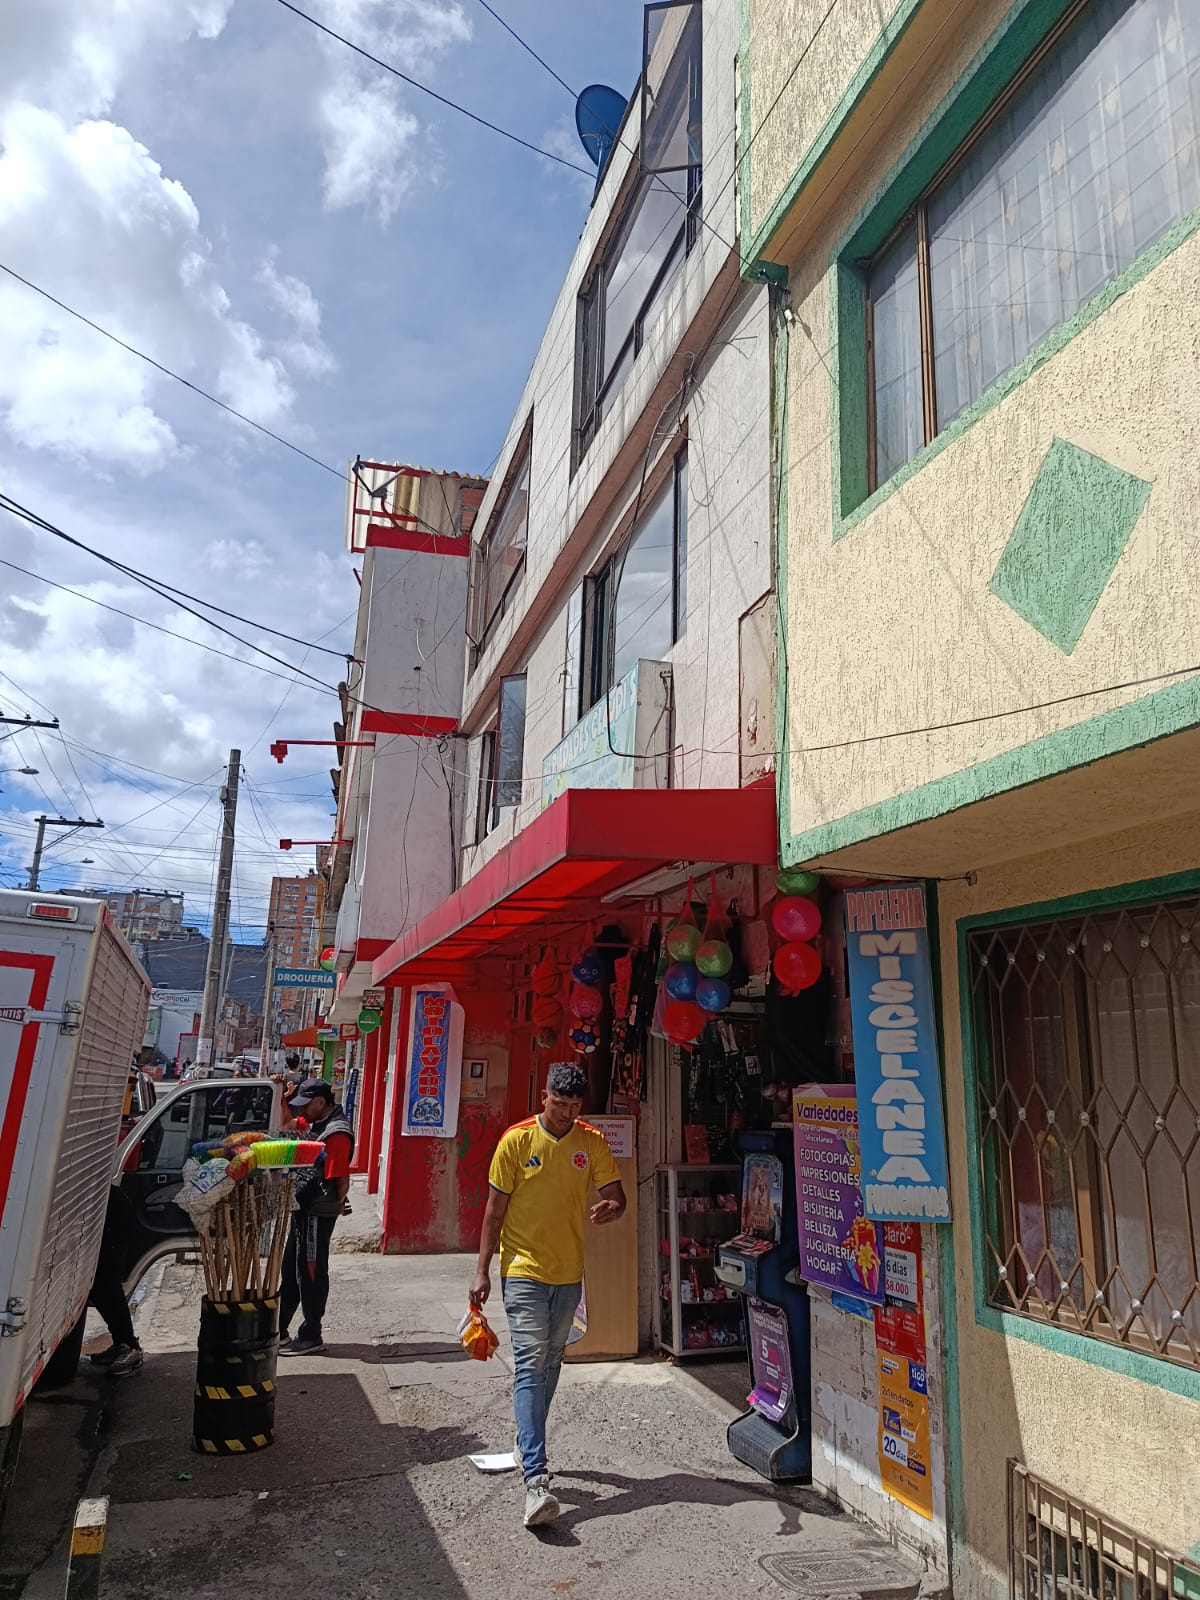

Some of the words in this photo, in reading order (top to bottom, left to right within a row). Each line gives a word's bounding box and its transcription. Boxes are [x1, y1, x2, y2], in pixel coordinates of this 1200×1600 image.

[847, 887, 927, 932] PAPELERIA
[277, 972, 334, 984] DROGUERÍA
[418, 996, 446, 1096] MOTOLAVADO
[859, 931, 932, 1183] MISCELANEA
[797, 1102, 858, 1123] Variedades
[800, 1148, 856, 1167] FOTOCOPIAS
[801, 1166, 860, 1186] IMPRESIONES
[802, 1183, 840, 1202] DETALLES
[803, 1201, 844, 1221] BISUTERÍA
[805, 1219, 838, 1239] BELLEZA
[806, 1237, 857, 1262] JUGUETERÍA
[806, 1255, 836, 1275] HOGAR
[886, 1260, 891, 1272] 6
[884, 1436, 896, 1456] 20
